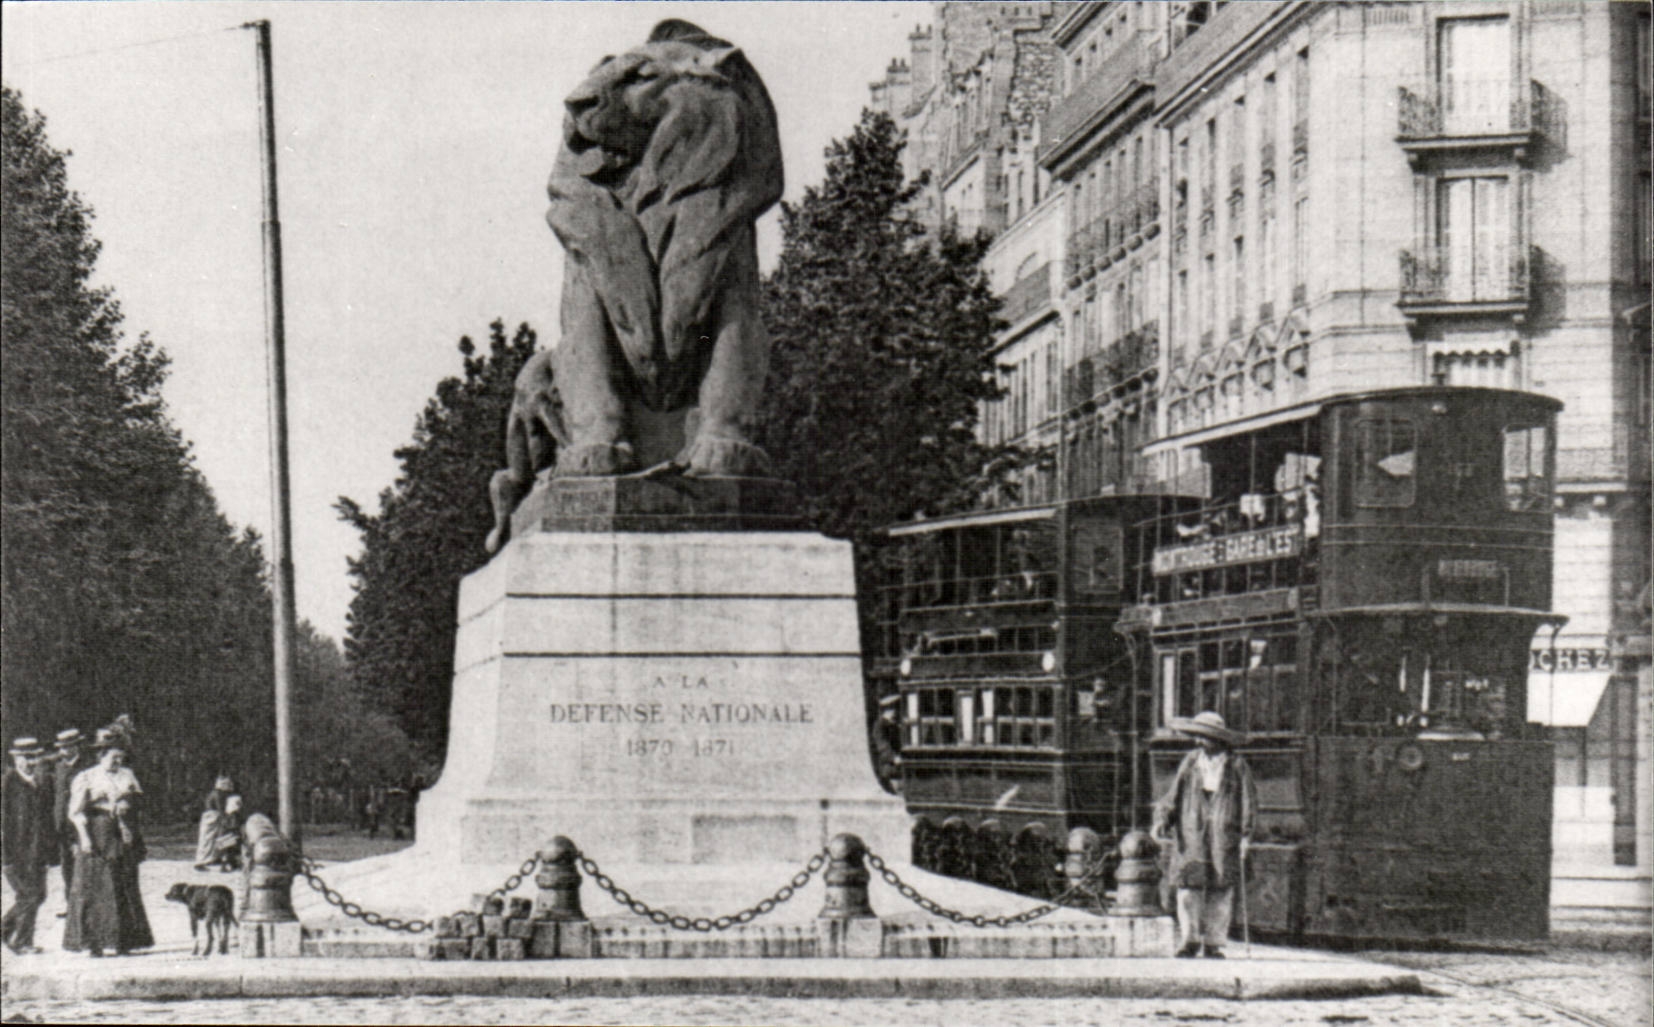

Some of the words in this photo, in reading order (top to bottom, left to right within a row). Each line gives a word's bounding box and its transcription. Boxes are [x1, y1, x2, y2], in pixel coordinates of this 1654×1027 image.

[1226, 534, 1256, 562] GARE
[652, 675, 666, 689] A
[682, 675, 709, 689] LA
[550, 702, 665, 724] DEFENSE
[680, 702, 814, 724] NATIONALE
[627, 738, 673, 757] 1870
[694, 738, 734, 757] 1871
